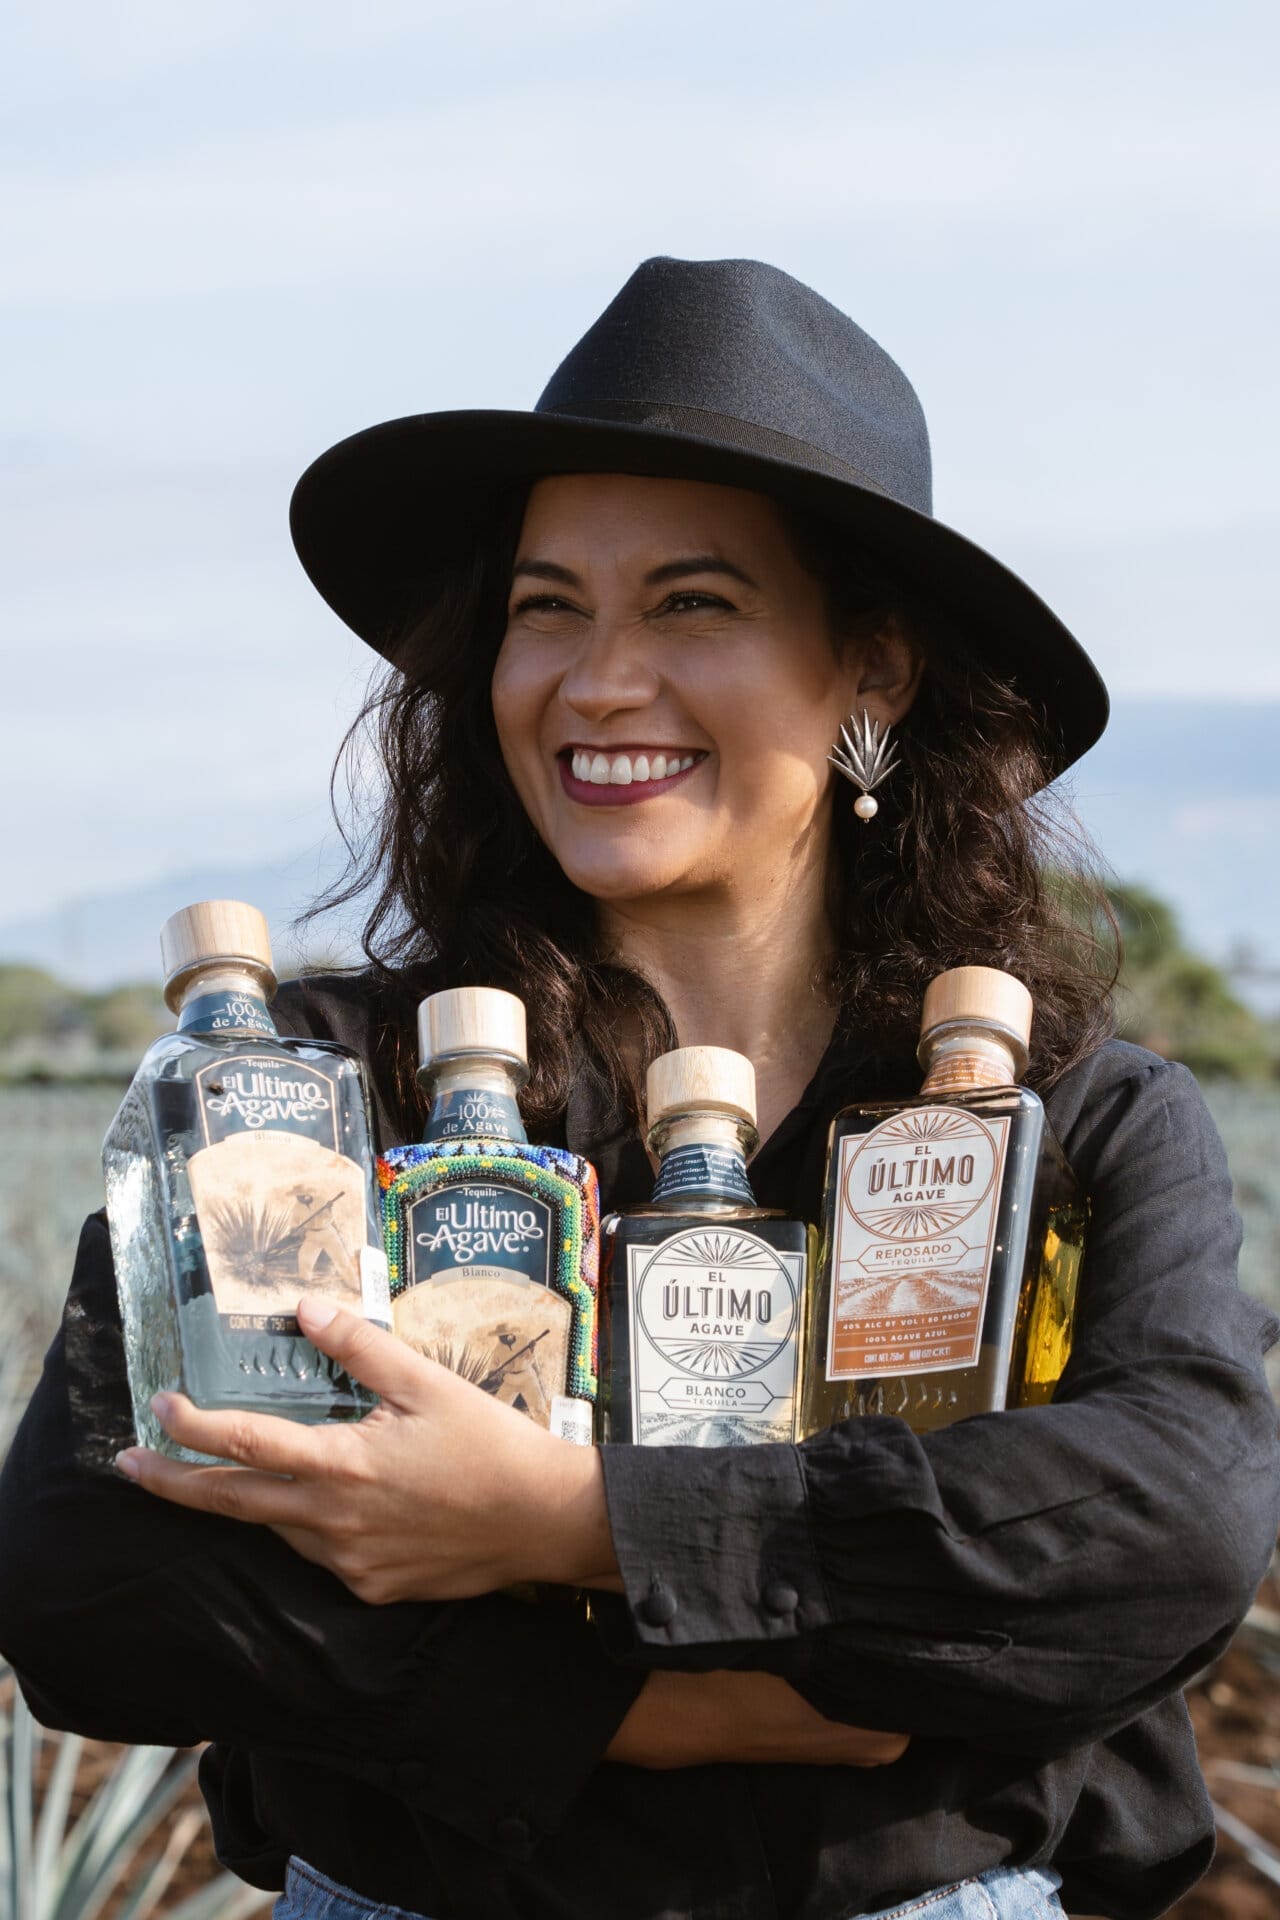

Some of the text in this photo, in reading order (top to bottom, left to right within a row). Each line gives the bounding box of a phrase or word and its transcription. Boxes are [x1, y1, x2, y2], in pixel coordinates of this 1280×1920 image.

[212, 1017, 230, 1028] de
[246, 1059, 280, 1069] Tequila
[222, 1072, 325, 1103] El Ultimo
[442, 1119, 509, 1136] de Agave
[914, 1145, 932, 1156] EL
[868, 1154, 975, 1196] ÚLTIMO
[462, 1187, 497, 1198] Tequila
[893, 1188, 946, 1203] AGAVE
[435, 1202, 541, 1234] El Ultimo
[876, 1243, 952, 1260] REPOSADO
[891, 1257, 934, 1266] TEQUILA
[461, 1267, 501, 1278] Blanco
[708, 1271, 727, 1283] EL
[663, 1279, 772, 1325] ÚLTIMO
[842, 1323, 861, 1331] 40%
[885, 1320, 897, 1328] BY
[900, 1318, 918, 1327] VOL
[928, 1316, 939, 1324] 80
[942, 1311, 972, 1321] PROOF
[690, 1323, 745, 1336] AGAVE
[865, 1329, 947, 1344] 100% AGAVE AZUL
[685, 1384, 747, 1399] BLANCO
[692, 1398, 738, 1408] TEQUILA
